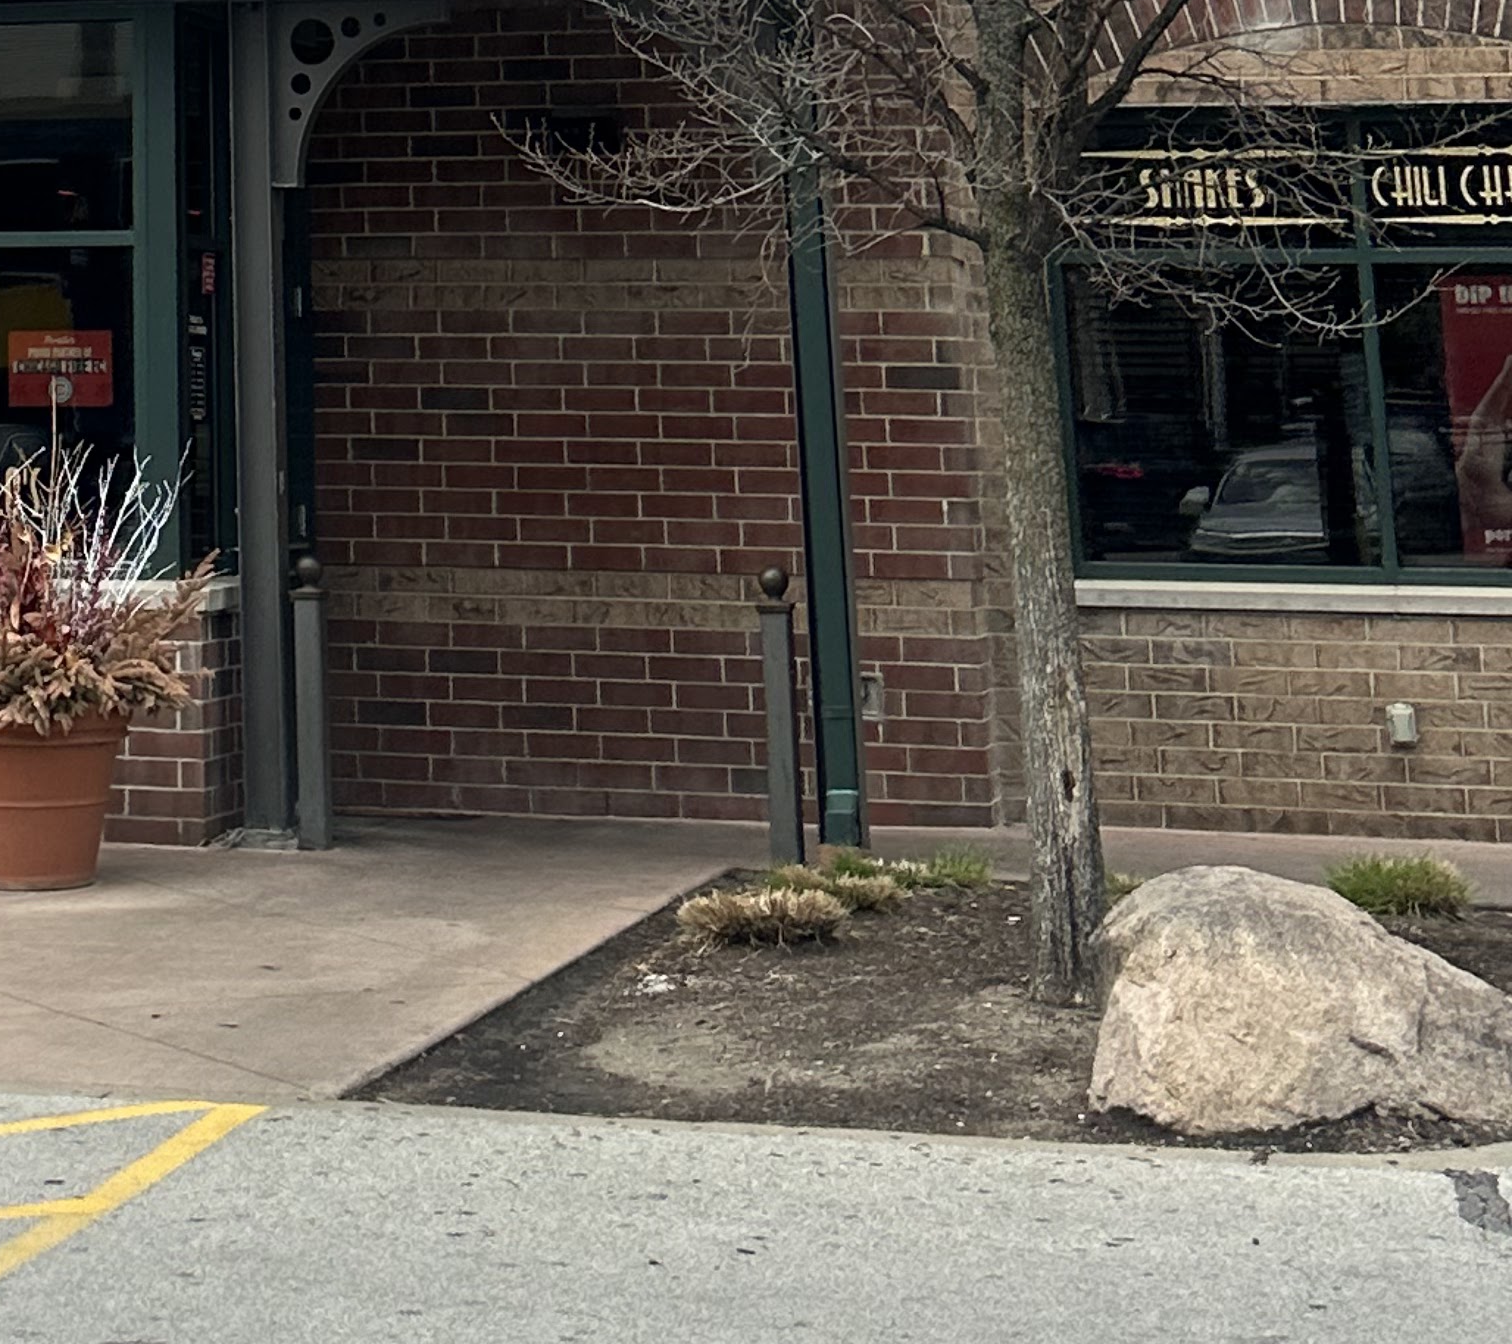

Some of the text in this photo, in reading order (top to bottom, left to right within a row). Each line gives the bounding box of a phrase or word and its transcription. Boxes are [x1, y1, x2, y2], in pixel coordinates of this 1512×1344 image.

[1139, 167, 1266, 209] SHAKES
[1370, 164, 1448, 207] CHILI
[1454, 284, 1493, 305] DIP
